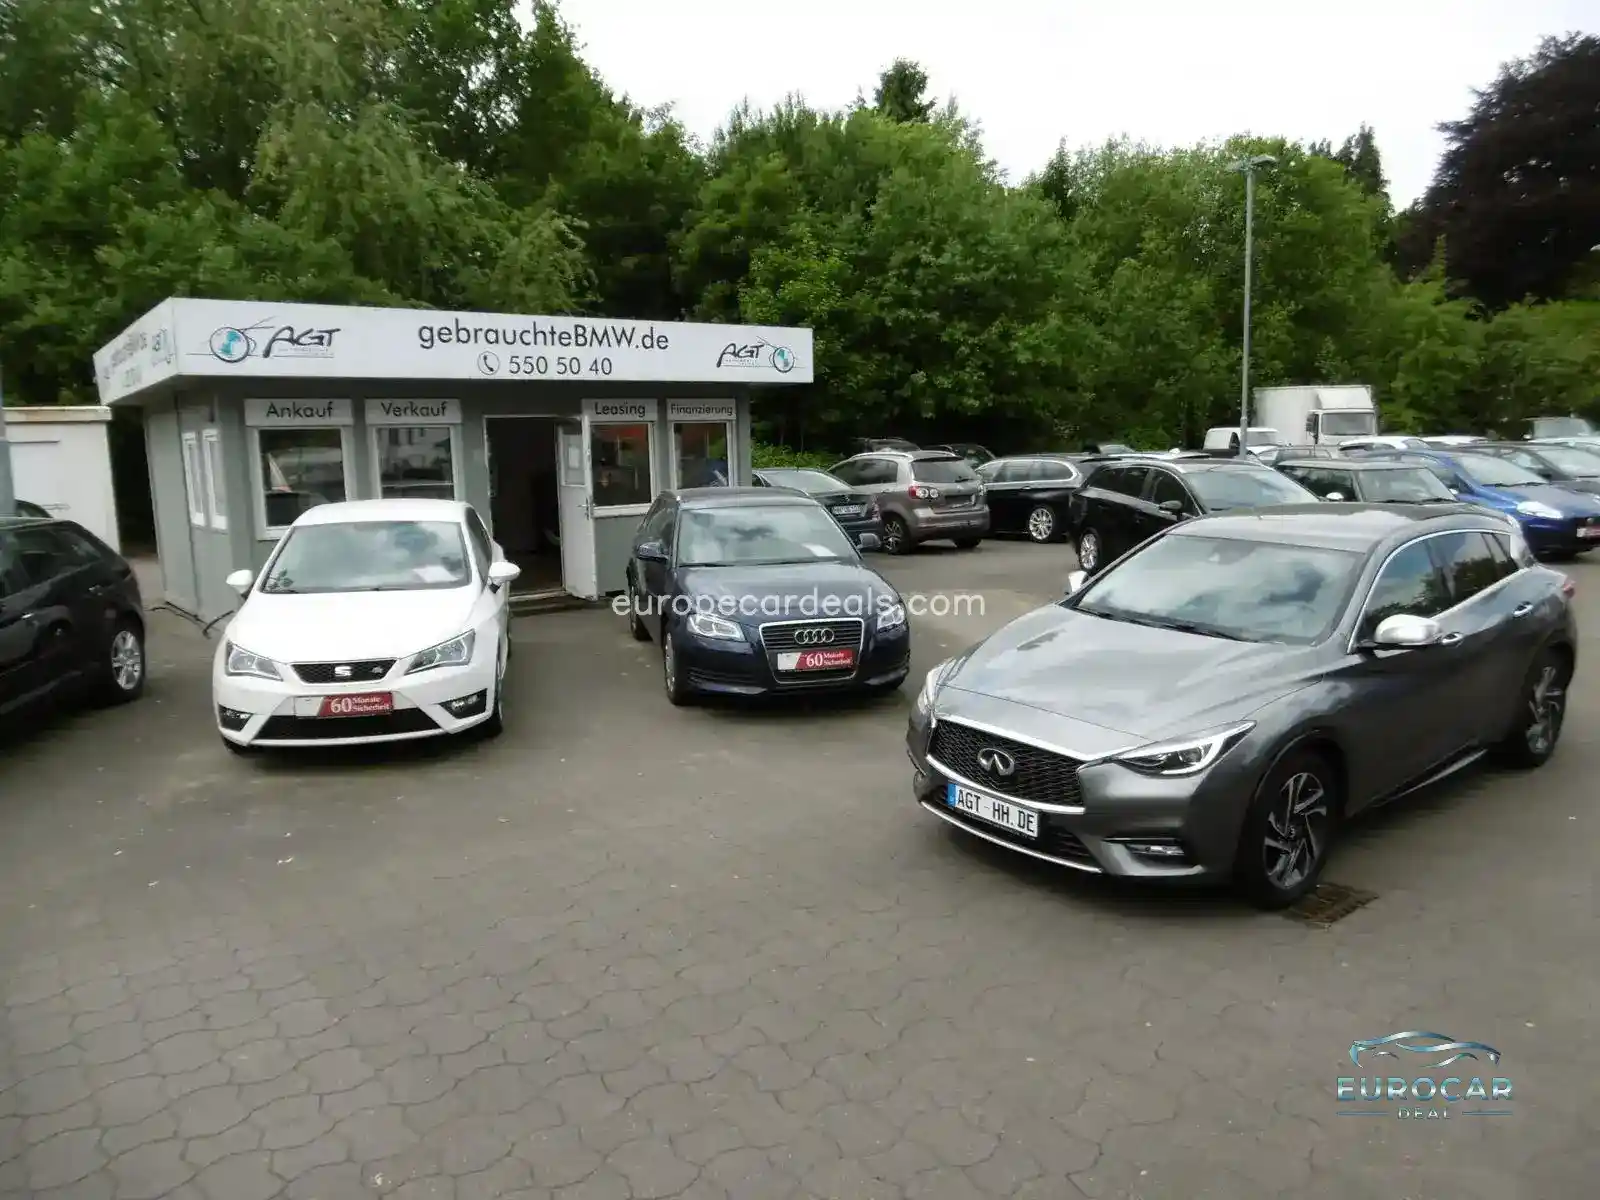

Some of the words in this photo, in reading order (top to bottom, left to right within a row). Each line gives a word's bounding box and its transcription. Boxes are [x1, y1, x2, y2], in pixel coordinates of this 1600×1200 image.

[262, 325, 342, 359] AGT
[418, 318, 670, 350] gebrauchteBMW.de
[716, 342, 765, 368] AGT
[508, 356, 548, 375] 550
[556, 357, 581, 375] 50
[588, 357, 613, 375] 40
[265, 401, 334, 418] Ankauf
[380, 400, 449, 417] Verkauf
[594, 402, 646, 418] Leasing
[670, 403, 733, 416] Finanzierung
[805, 652, 823, 667] 60
[330, 697, 353, 714] 60
[957, 788, 981, 813] AGT
[992, 801, 1035, 834] HH.DE
